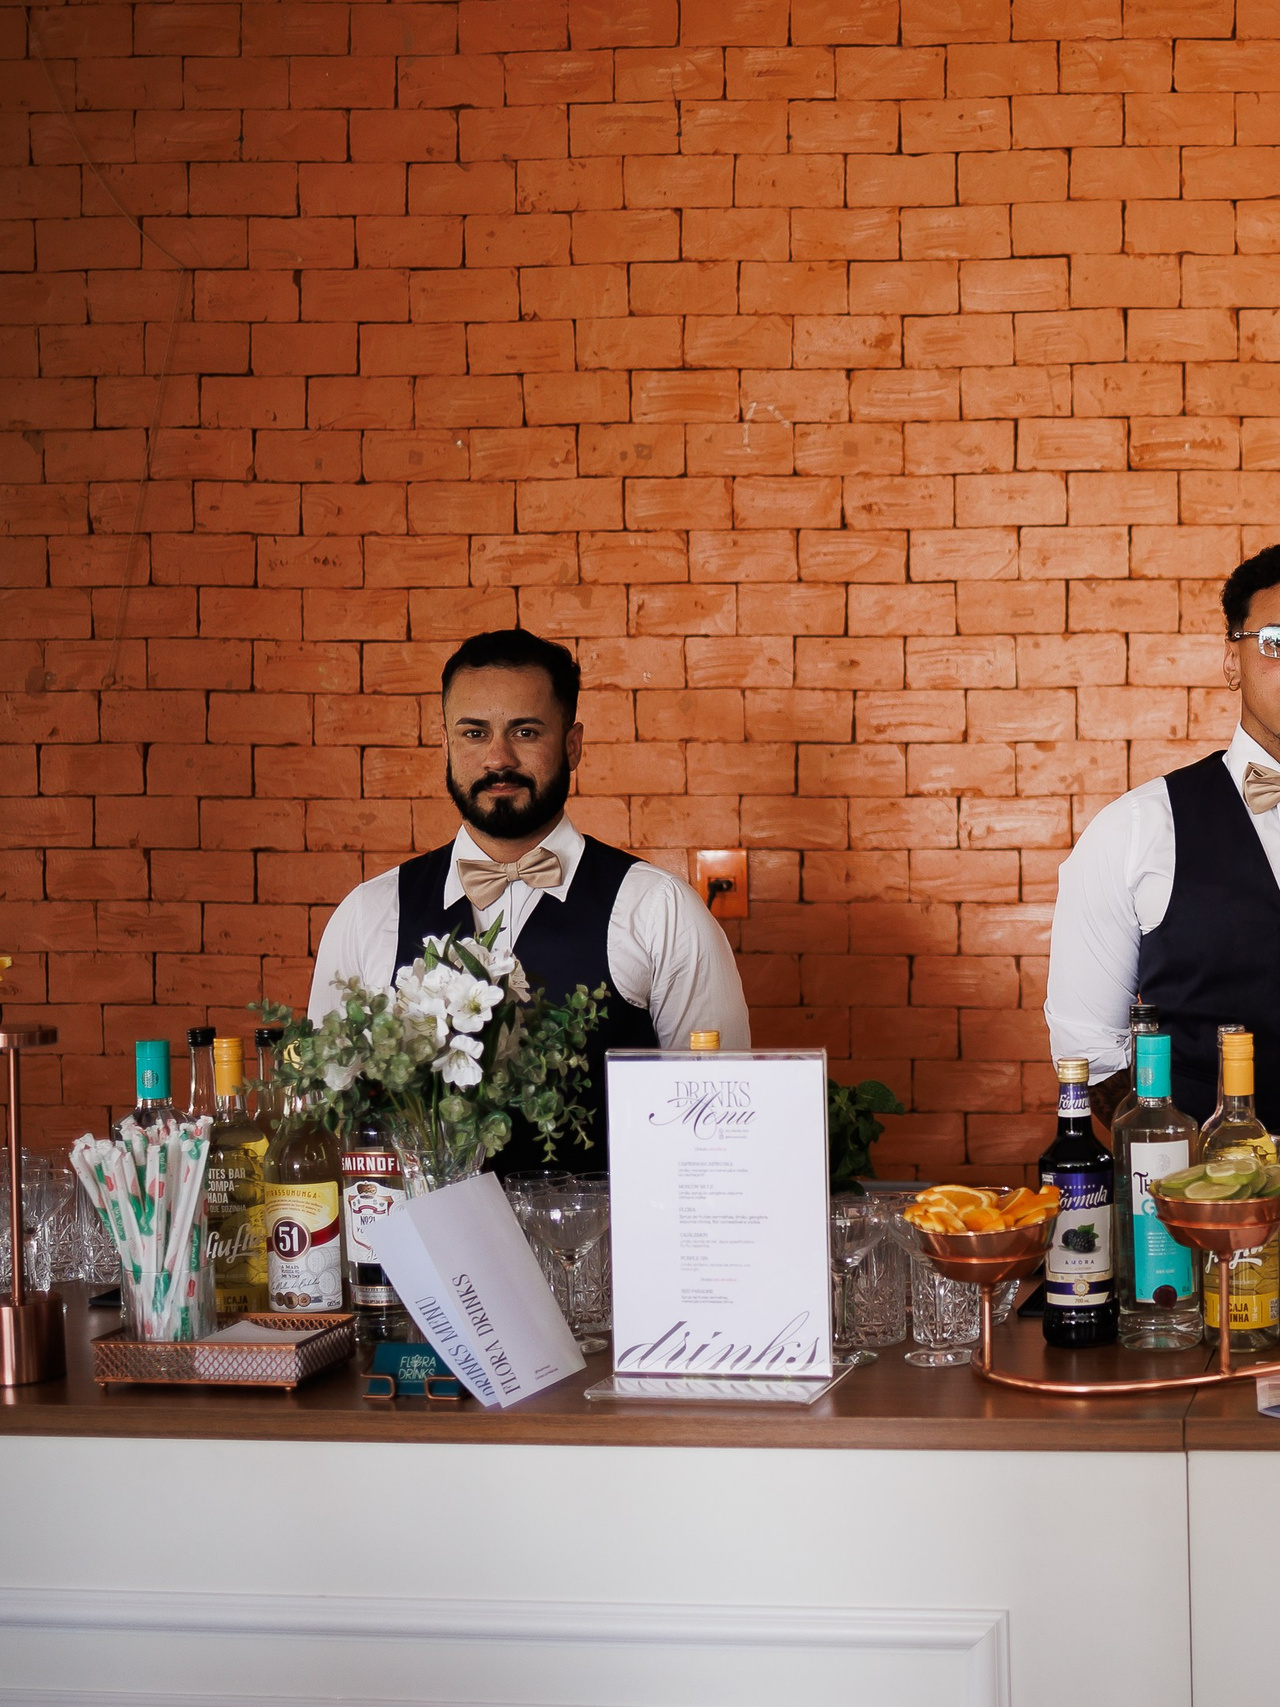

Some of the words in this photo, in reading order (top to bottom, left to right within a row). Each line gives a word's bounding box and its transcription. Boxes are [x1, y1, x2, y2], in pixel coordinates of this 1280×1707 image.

[675, 1081, 751, 1107] DRINKS
[228, 1168, 246, 1179] BAR
[342, 1157, 401, 1171] MIRNOF
[208, 1181, 240, 1192] OMPA-
[278, 1226, 299, 1251] 51
[452, 1273, 494, 1337] DRINKS
[1229, 1313, 1249, 1322] INHA
[415, 1296, 454, 1343] MENU
[618, 1311, 825, 1371] drinks
[400, 1354, 437, 1368] FLORA
[448, 1343, 495, 1397] DRINKS
[485, 1339, 521, 1395] FLORA
[398, 1368, 435, 1380] DRINKS
